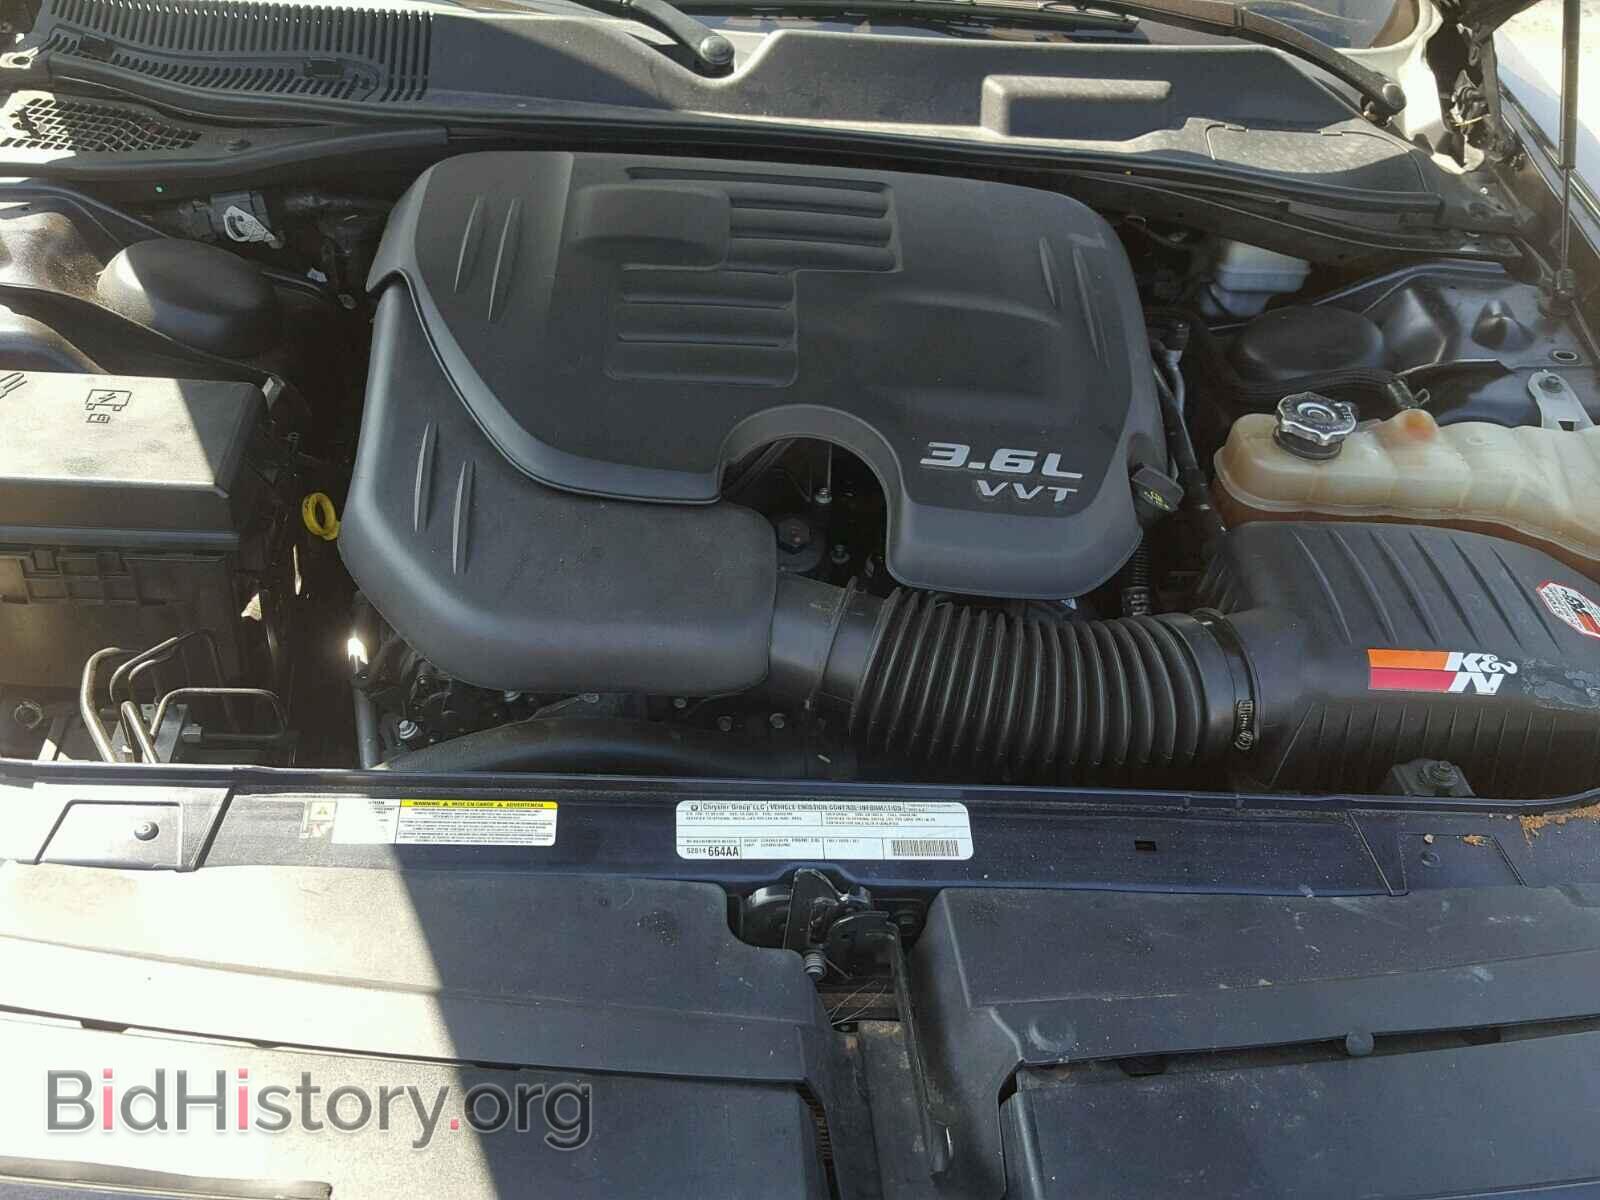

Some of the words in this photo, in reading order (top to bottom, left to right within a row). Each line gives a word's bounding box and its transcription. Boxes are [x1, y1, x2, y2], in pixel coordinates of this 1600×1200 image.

[920, 441, 1083, 479] 3.6L
[976, 479, 1078, 503] VVT
[703, 803, 729, 811] Chrysler
[731, 803, 750, 812] Group
[708, 846, 739, 857] 664AA
